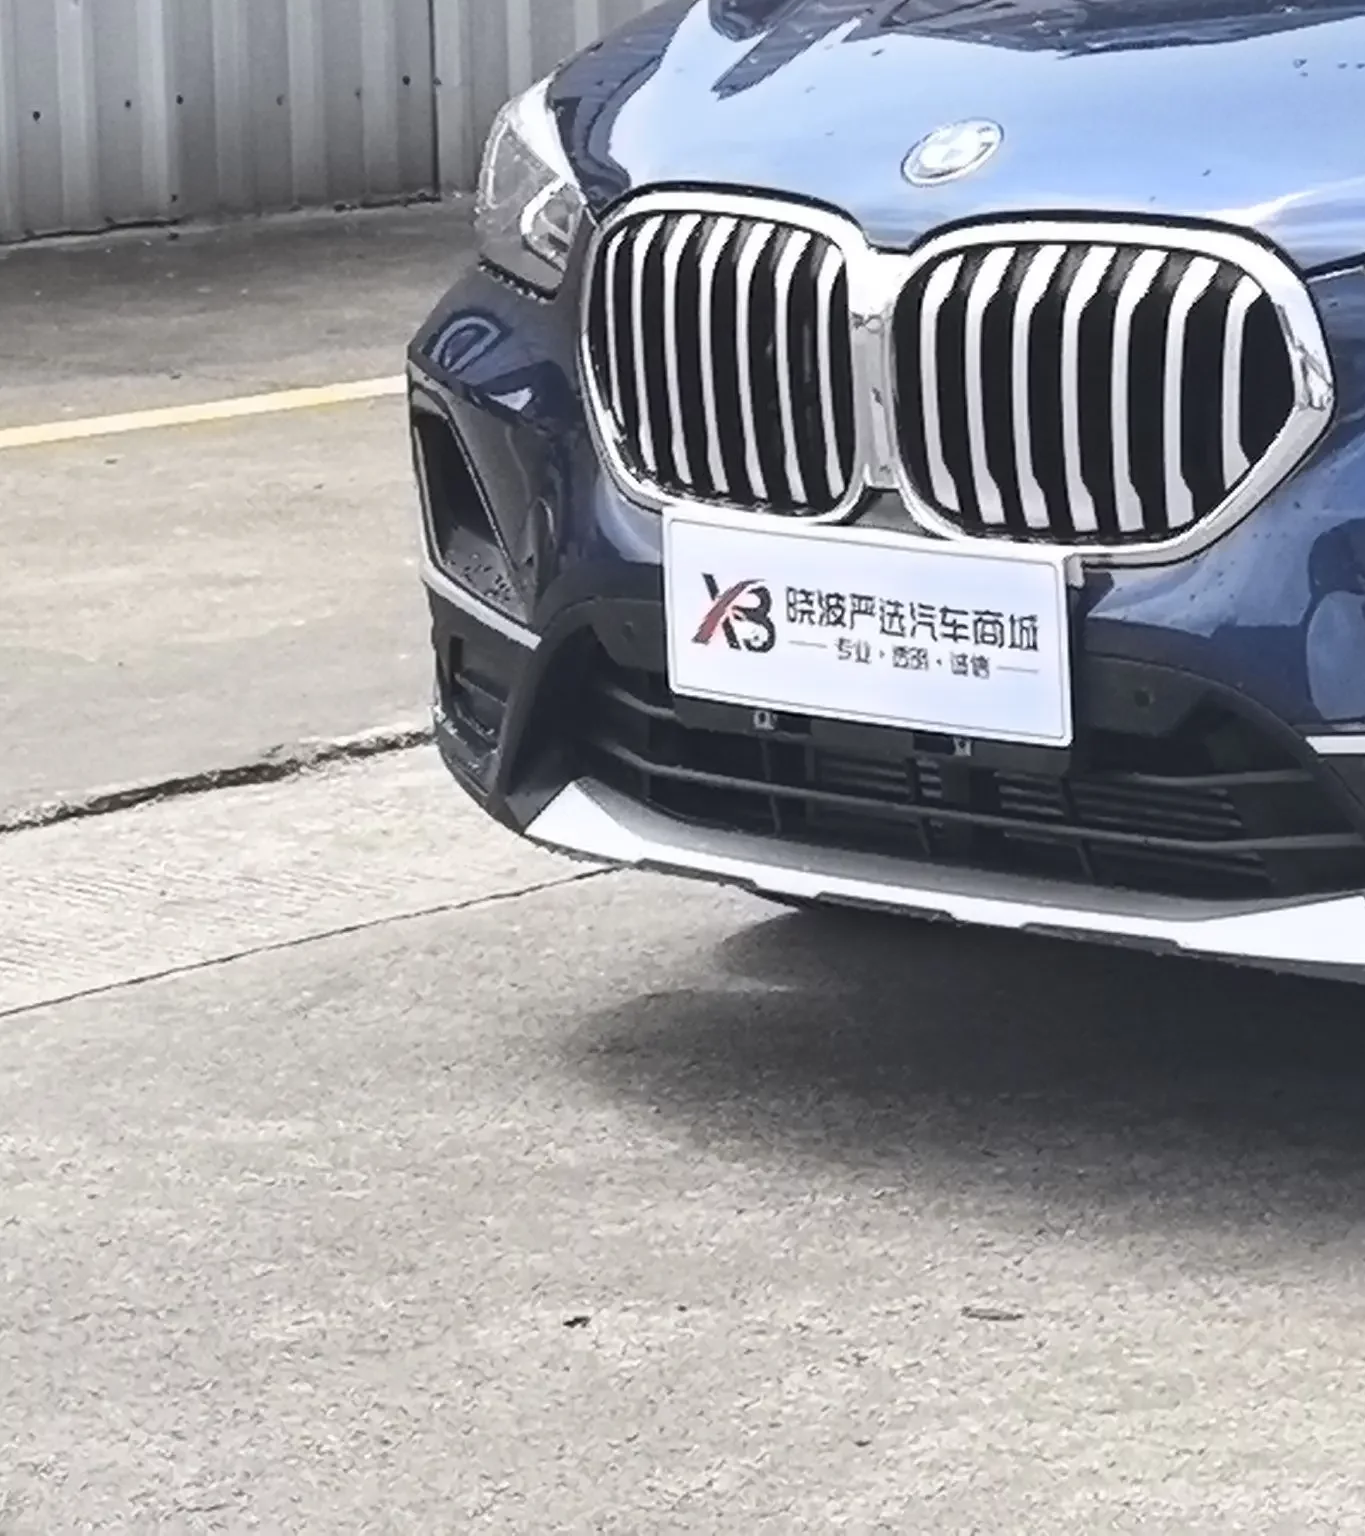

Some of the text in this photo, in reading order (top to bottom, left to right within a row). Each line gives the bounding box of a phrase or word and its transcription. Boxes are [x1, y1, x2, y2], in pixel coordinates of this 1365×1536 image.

[786, 585, 1039, 652] 晓波严选汽车商城
